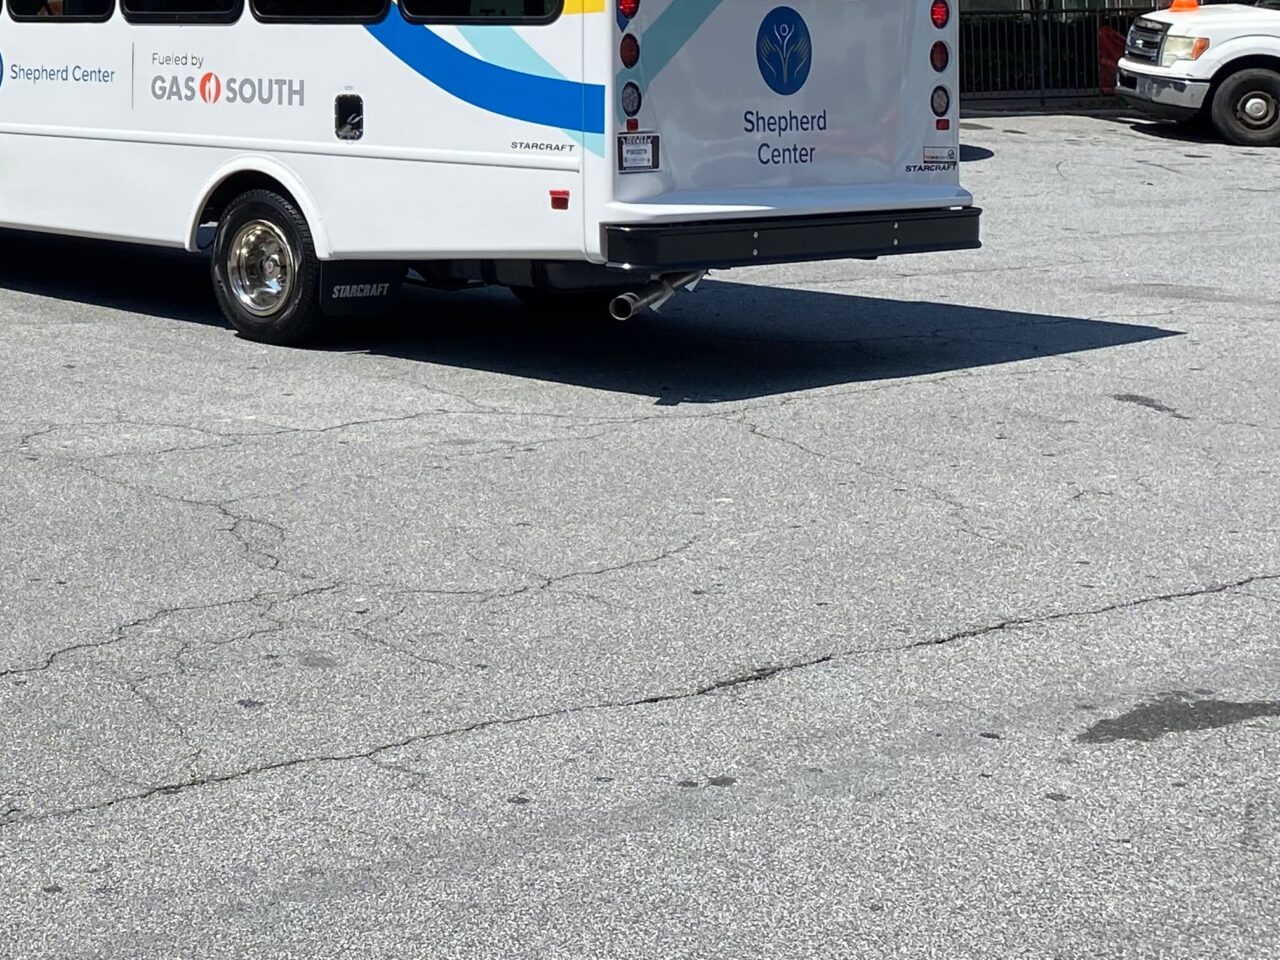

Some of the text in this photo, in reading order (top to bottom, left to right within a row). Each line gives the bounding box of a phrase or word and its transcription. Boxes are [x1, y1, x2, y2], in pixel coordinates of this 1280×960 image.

[152, 52, 204, 68] Fueled by
[10, 63, 115, 83] Shepherd Center
[151, 75, 305, 106] GAS SOUTH
[743, 109, 827, 137] Shepherd
[510, 141, 575, 152] STARCRAFT
[757, 143, 816, 165] Center
[905, 164, 957, 172] STARCRAFT
[331, 283, 390, 298] STARCRAFT
